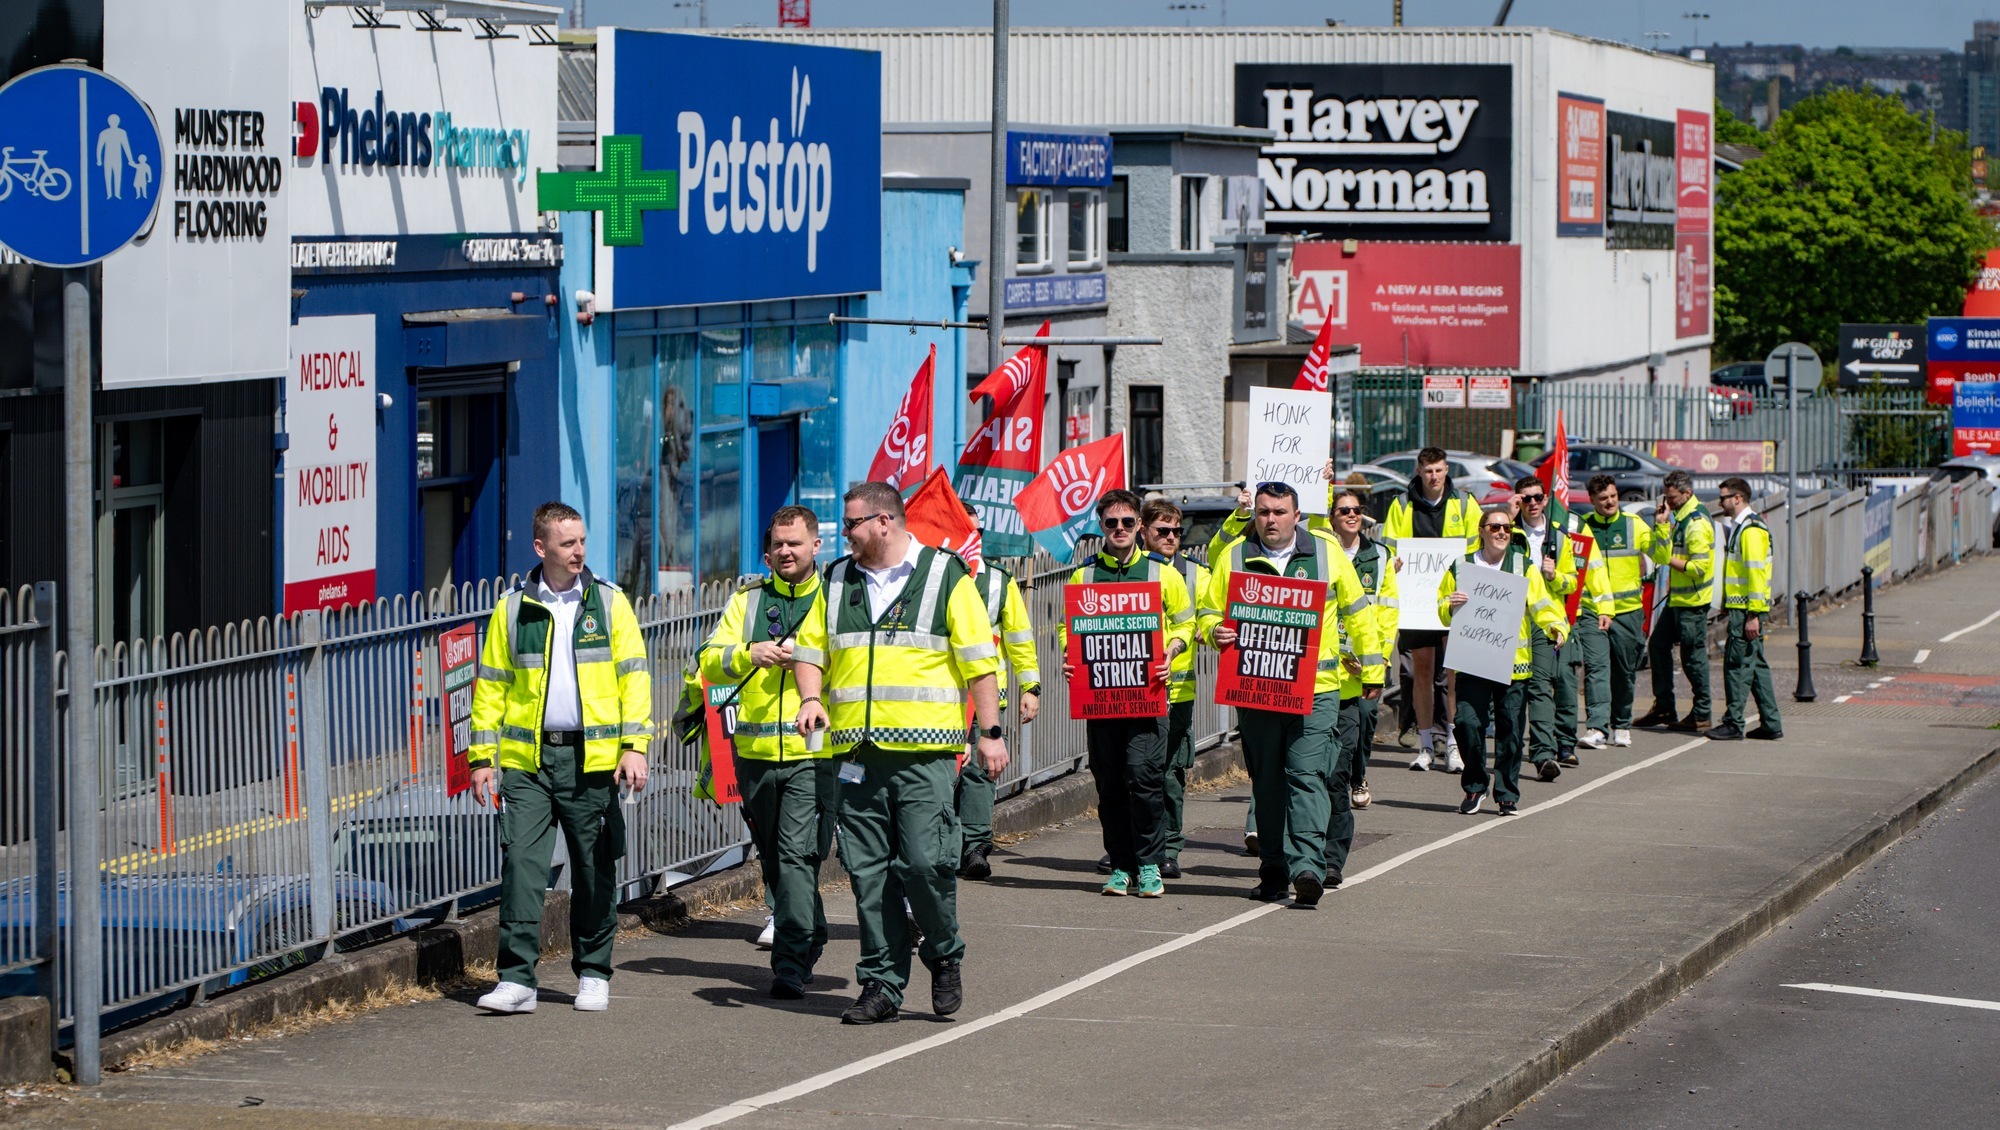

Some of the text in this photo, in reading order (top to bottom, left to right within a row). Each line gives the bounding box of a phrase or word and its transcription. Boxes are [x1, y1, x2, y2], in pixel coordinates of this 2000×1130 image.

[175, 108, 264, 146] MUNSTER
[1264, 89, 1479, 152] Harvey
[321, 87, 529, 184] Phelans Pharmacy
[1020, 141, 1106, 178] FACTORY CARPETS
[175, 154, 281, 192] HARDWOOD
[1258, 158, 1489, 211] Norman
[677, 111, 832, 273] Petstop
[175, 200, 267, 238] FLOORING
[1297, 276, 1340, 318] Ai
[1376, 285, 1504, 297] A NEW AI ERA BEGINS
[1371, 301, 1509, 317] The fastest, most intelligent
[1392, 315, 1487, 327] Windows PCs ever.
[1871, 348, 1904, 359] GOLF
[301, 350, 365, 391] MEDICAL
[1964, 371, 1995, 383] South
[1427, 390, 1444, 402] NO
[1264, 402, 1312, 426] HONK
[328, 413, 338, 450] &
[1957, 430, 2000, 441] TILE SALE
[1272, 433, 1302, 455] FOR
[1255, 458, 1324, 485] SUPPORT
[299, 462, 368, 507] MOBILITY
[316, 525, 350, 567] AIDS
[1408, 552, 1449, 575] HONK
[318, 581, 348, 605] phelans.ie
[1100, 592, 1151, 613] SIPTU
[1260, 585, 1313, 608] SIPTU
[1473, 582, 1513, 603] HONK
[1074, 616, 1158, 632] AMBULANCE SECTOR
[1231, 604, 1317, 626] AMBULANCE SECTOR
[1474, 605, 1497, 623] FOR
[1085, 633, 1150, 661] OFFICIAL
[1239, 622, 1303, 654] OFFICIAL
[1459, 625, 1514, 649] SUPPORT
[453, 636, 472, 664] SIPTU
[1093, 661, 1145, 688] STRIKE
[1242, 649, 1296, 680] STRIKE
[1094, 689, 1147, 702] HSE NATIONAL
[1239, 678, 1292, 696] HSE NATIONAL
[1082, 700, 1160, 716] AMBULANCE SERVICE
[1225, 689, 1304, 710] AMBULANCE SERVICE
